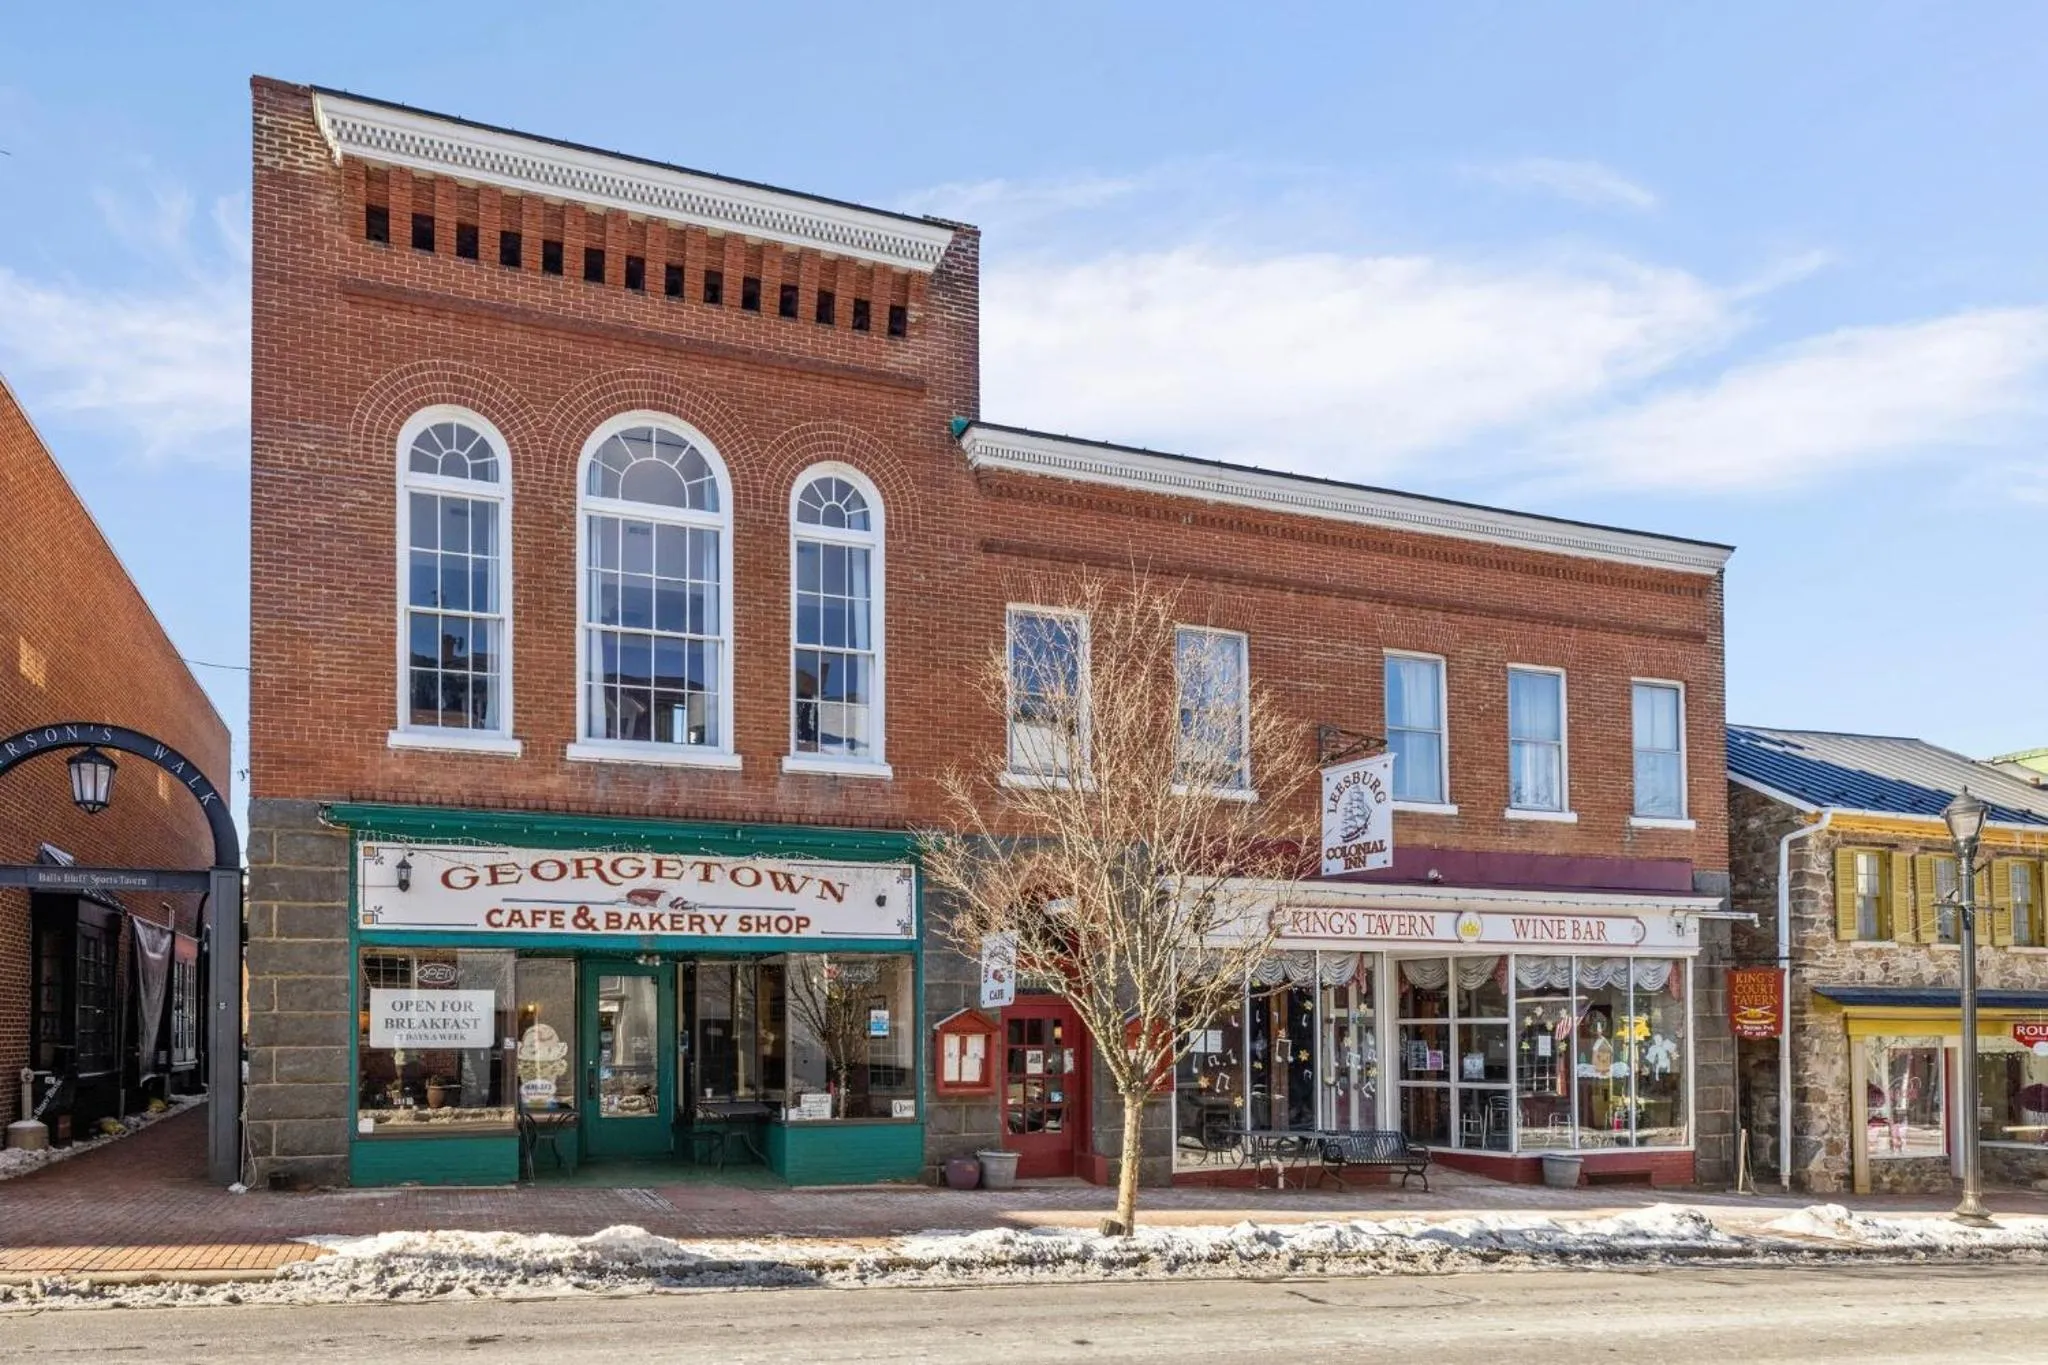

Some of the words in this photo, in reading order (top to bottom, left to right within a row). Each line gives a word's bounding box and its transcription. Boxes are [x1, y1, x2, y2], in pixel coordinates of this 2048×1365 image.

[0, 725, 113, 765] RSON'S
[153, 744, 217, 807] WALK
[1327, 770, 1387, 814] LEESBURG
[1325, 839, 1387, 860] COLONIAL
[1344, 855, 1367, 870] INN
[90, 874, 118, 886] Sports
[120, 876, 147, 886] Tavern
[440, 856, 850, 904] GEORGETOWN
[486, 909, 566, 929] CAFE
[571, 905, 599, 932] &
[604, 912, 727, 934] BAKERY
[737, 915, 811, 935] SHOP
[1291, 911, 1357, 935] KING'S
[1362, 913, 1436, 938] TAVERN
[1511, 918, 1567, 940] WINE
[1571, 919, 1608, 942] BAR
[418, 968, 456, 980] OPEN
[1736, 972, 1775, 984] KING'S
[989, 989, 1005, 1001] CAFE
[1736, 983, 1776, 994] COURT
[391, 1000, 436, 1013] OPEN
[441, 1000, 474, 1013] FOR
[1733, 994, 1778, 1006] TAVERN
[384, 1017, 481, 1030] BREAKFAST
[406, 1032, 431, 1042] DAYS
[440, 1032, 467, 1042] WEEK
